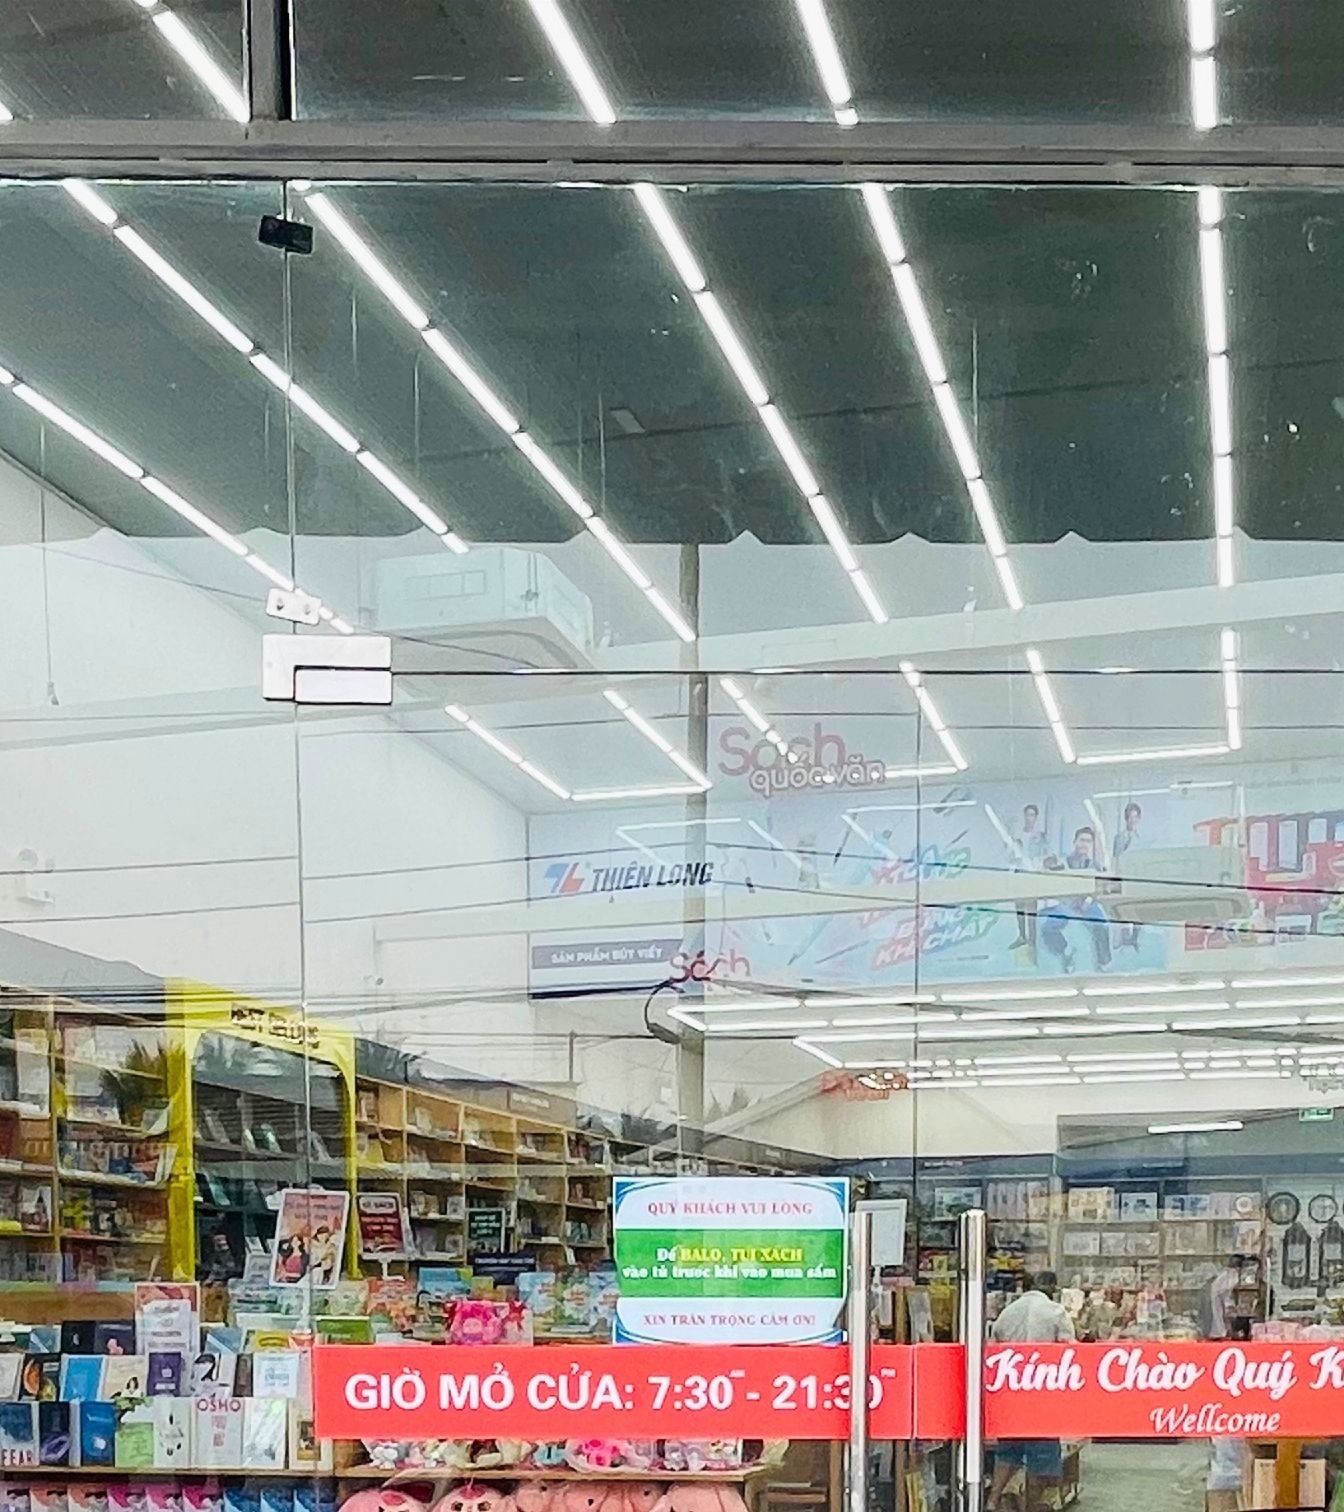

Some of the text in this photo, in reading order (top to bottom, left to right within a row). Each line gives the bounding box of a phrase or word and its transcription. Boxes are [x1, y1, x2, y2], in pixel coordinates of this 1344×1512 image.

[592, 862, 714, 893] THIÊN LONG
[741, 1203, 766, 1214] VUI
[680, 1248, 726, 1263] BALO,
[714, 1264, 738, 1278] khi
[771, 1268, 803, 1278] mua
[643, 1314, 666, 1326] XIN
[985, 1348, 1086, 1392] Kính
[1097, 1347, 1206, 1392] Chào
[1212, 1347, 1298, 1400] Quý
[344, 1366, 426, 1410] GIỜ
[439, 1361, 515, 1410] MỞ
[526, 1362, 635, 1410] CỬA:
[647, 1375, 733, 1410] 7:30
[197, 1398, 241, 1412] OSHO
[1149, 1403, 1281, 1433] Wellcome
[1, 1448, 34, 1466] FEAR
